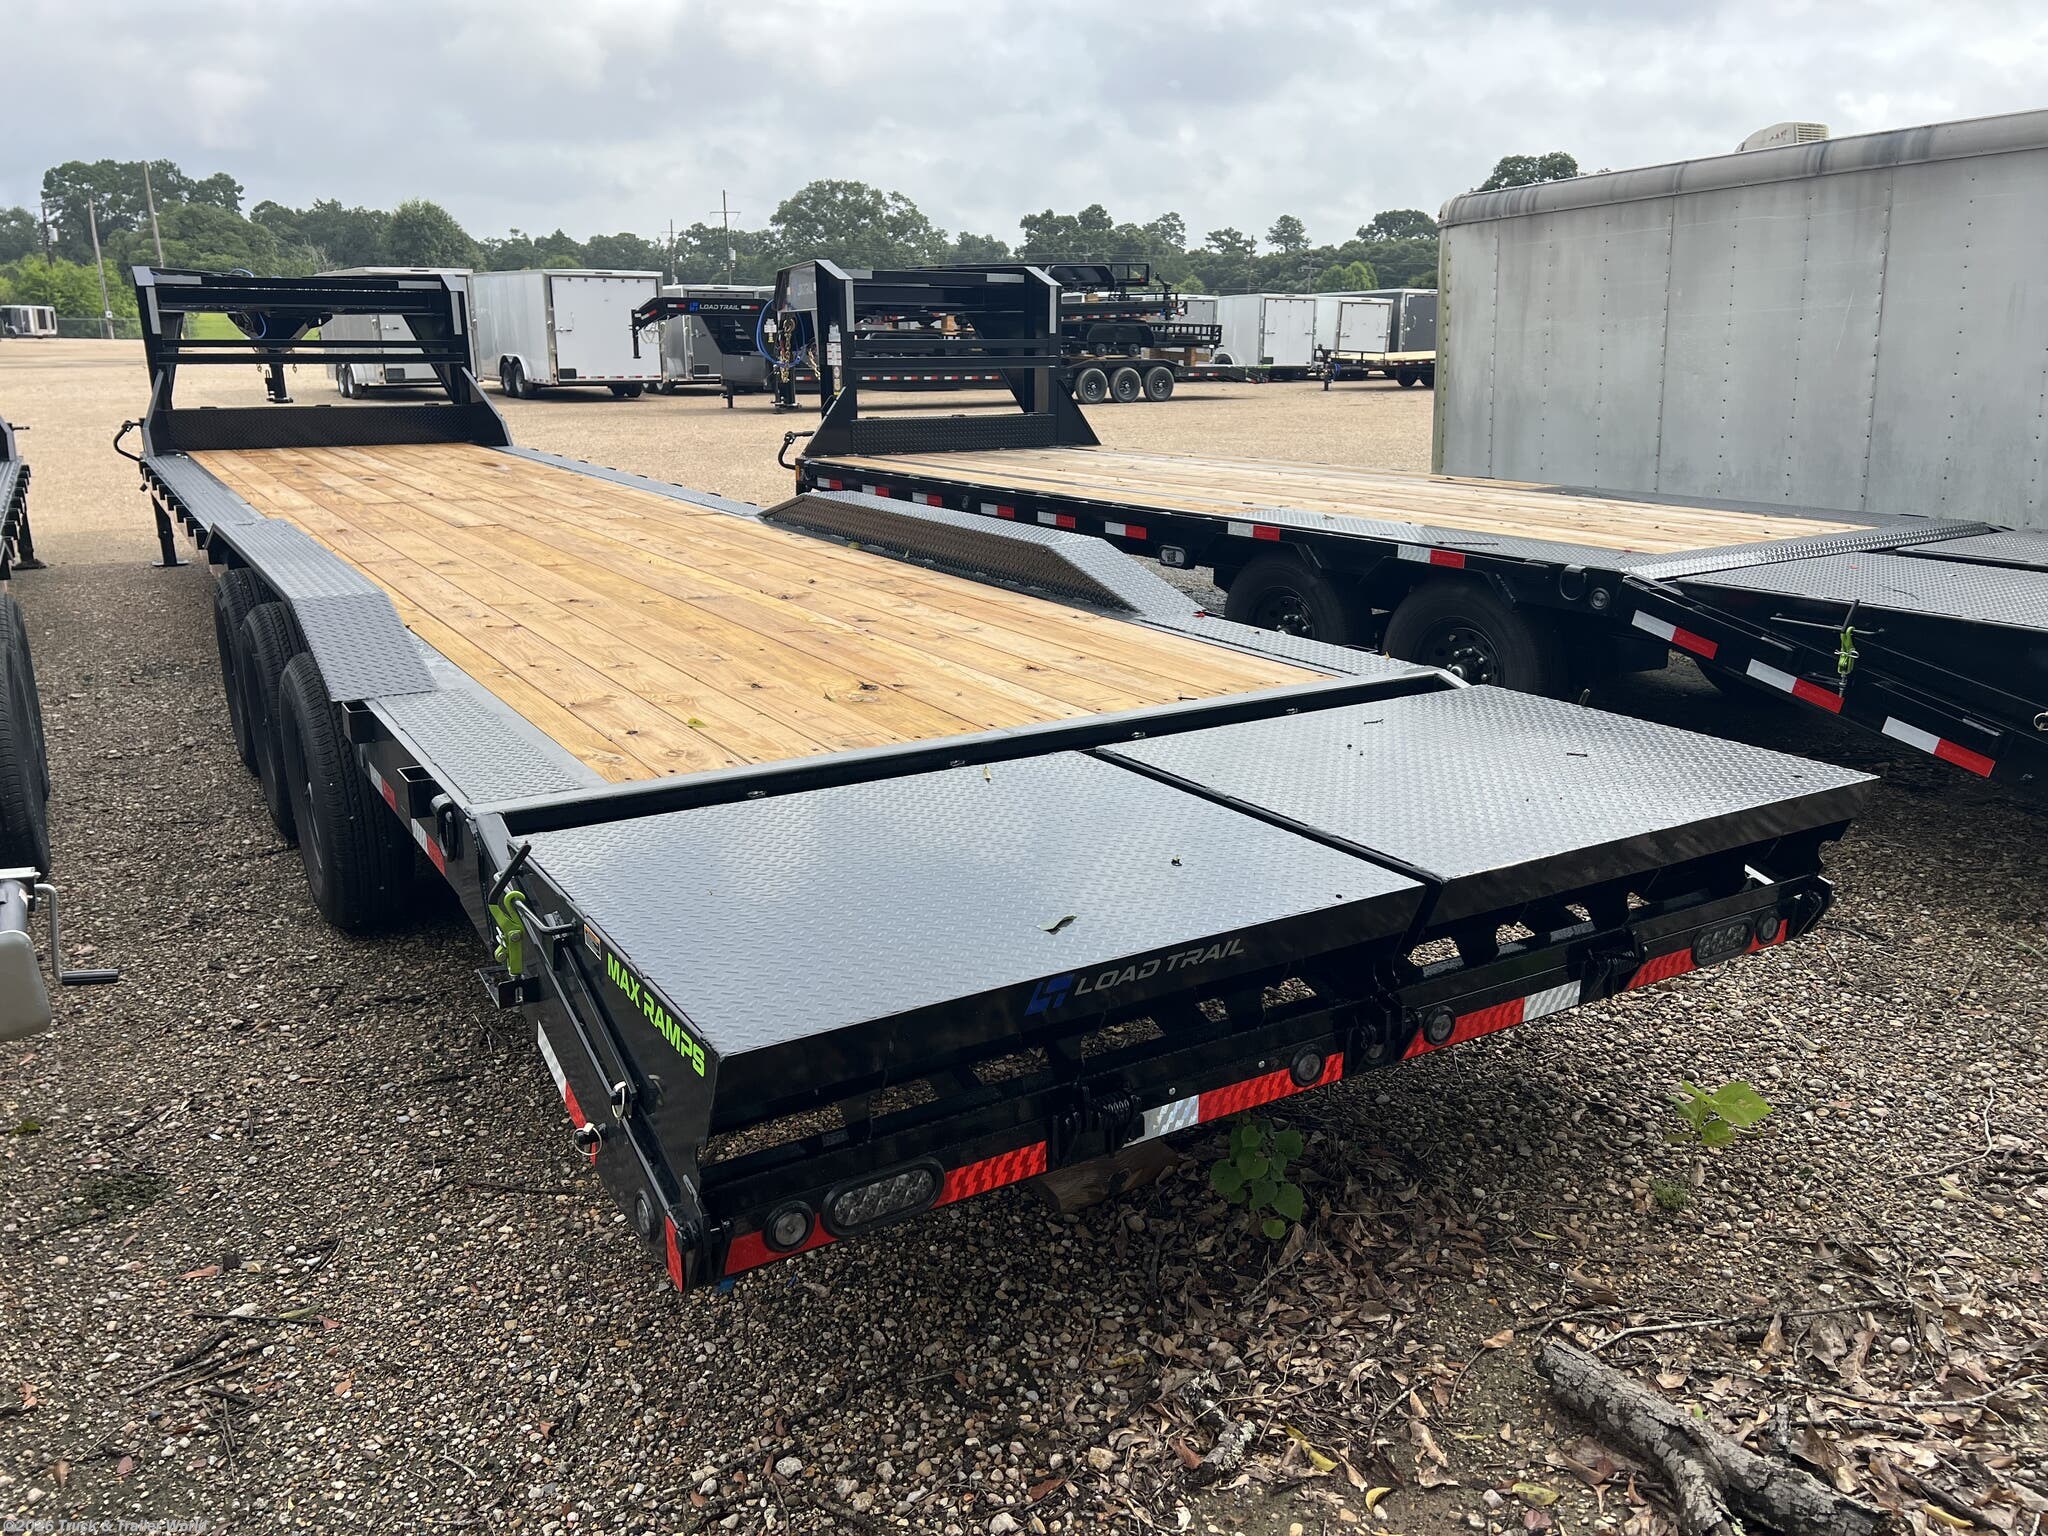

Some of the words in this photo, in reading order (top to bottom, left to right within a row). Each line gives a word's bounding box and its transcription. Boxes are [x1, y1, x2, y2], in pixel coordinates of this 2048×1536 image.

[1074, 958, 1162, 996] LOAD
[1166, 938, 1245, 973] TRAIL
[607, 952, 641, 1009] MAX
[643, 991, 705, 1078] RAMPS
